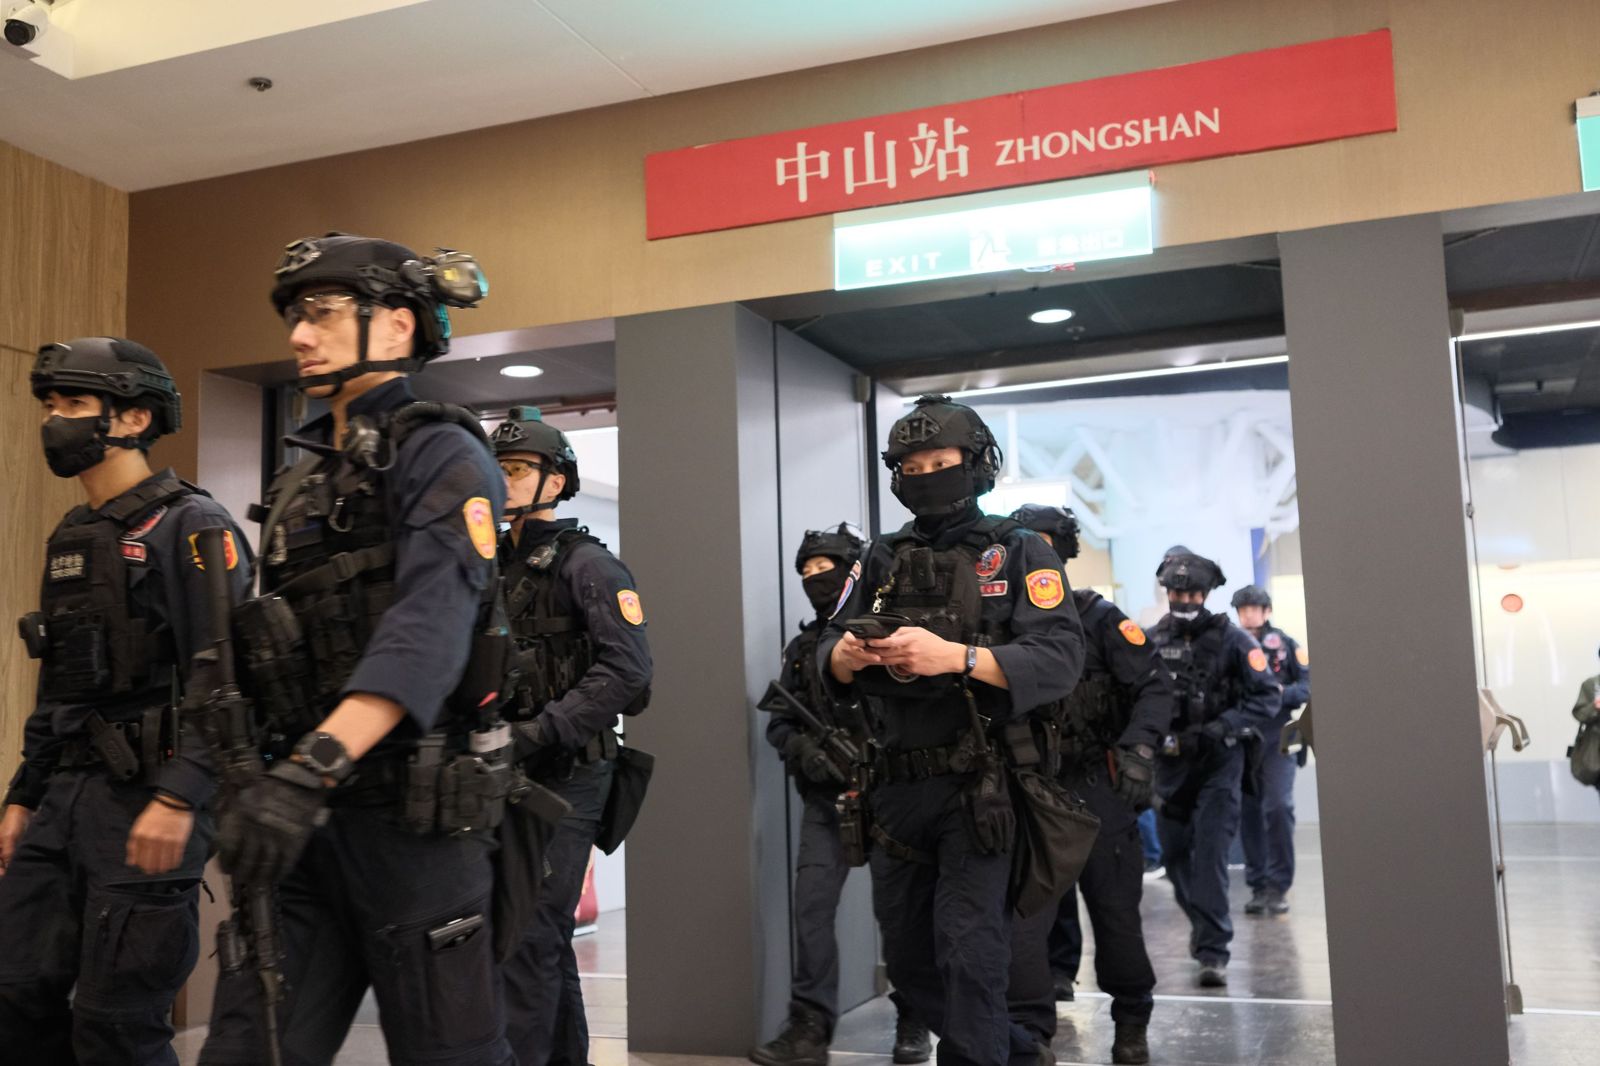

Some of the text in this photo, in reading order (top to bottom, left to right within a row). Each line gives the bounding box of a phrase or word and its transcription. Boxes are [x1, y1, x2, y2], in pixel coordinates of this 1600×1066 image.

[776, 107, 1220, 203] 中山站 ZHONGSHAN
[865, 251, 942, 278] EXIT
